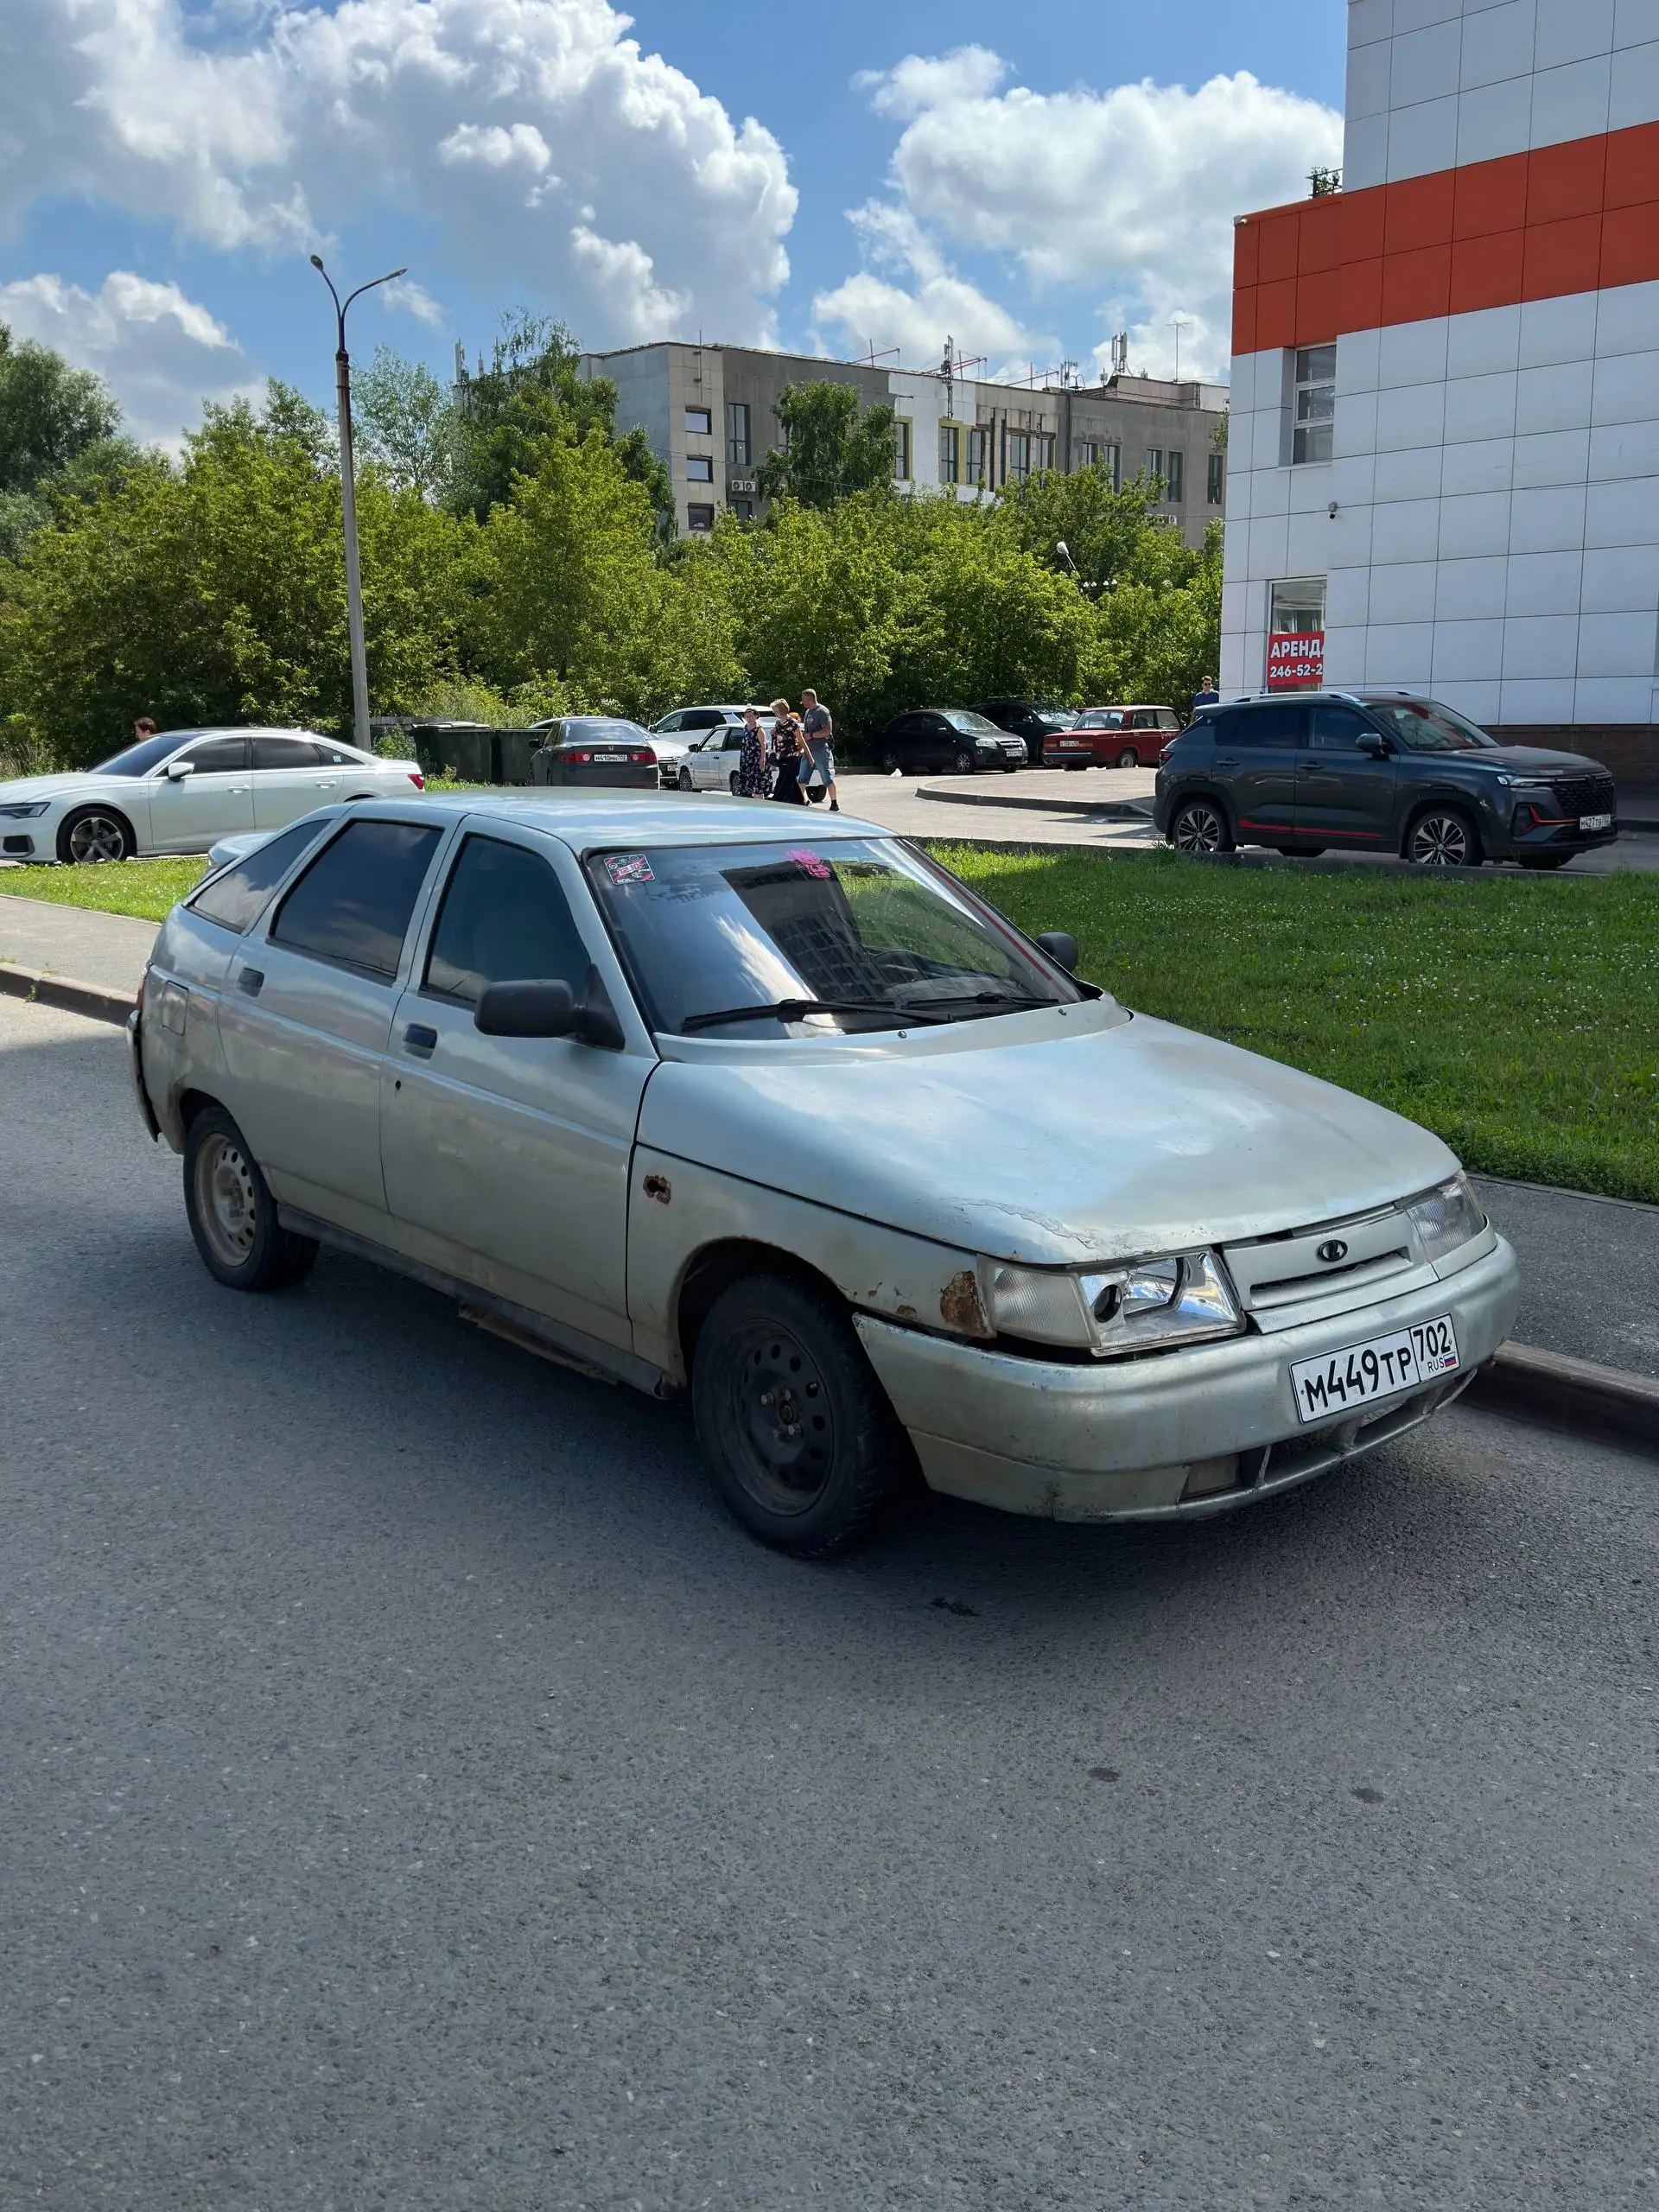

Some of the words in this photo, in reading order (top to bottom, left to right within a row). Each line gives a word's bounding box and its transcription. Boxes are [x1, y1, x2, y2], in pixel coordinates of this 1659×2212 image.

[1270, 639, 1325, 658] АРЕНД
[1269, 663, 1323, 678] 246-52-2
[1304, 1346, 1412, 1412] М449ТР
[1413, 1321, 1451, 1362] 702
[1427, 1357, 1445, 1373] RUS
